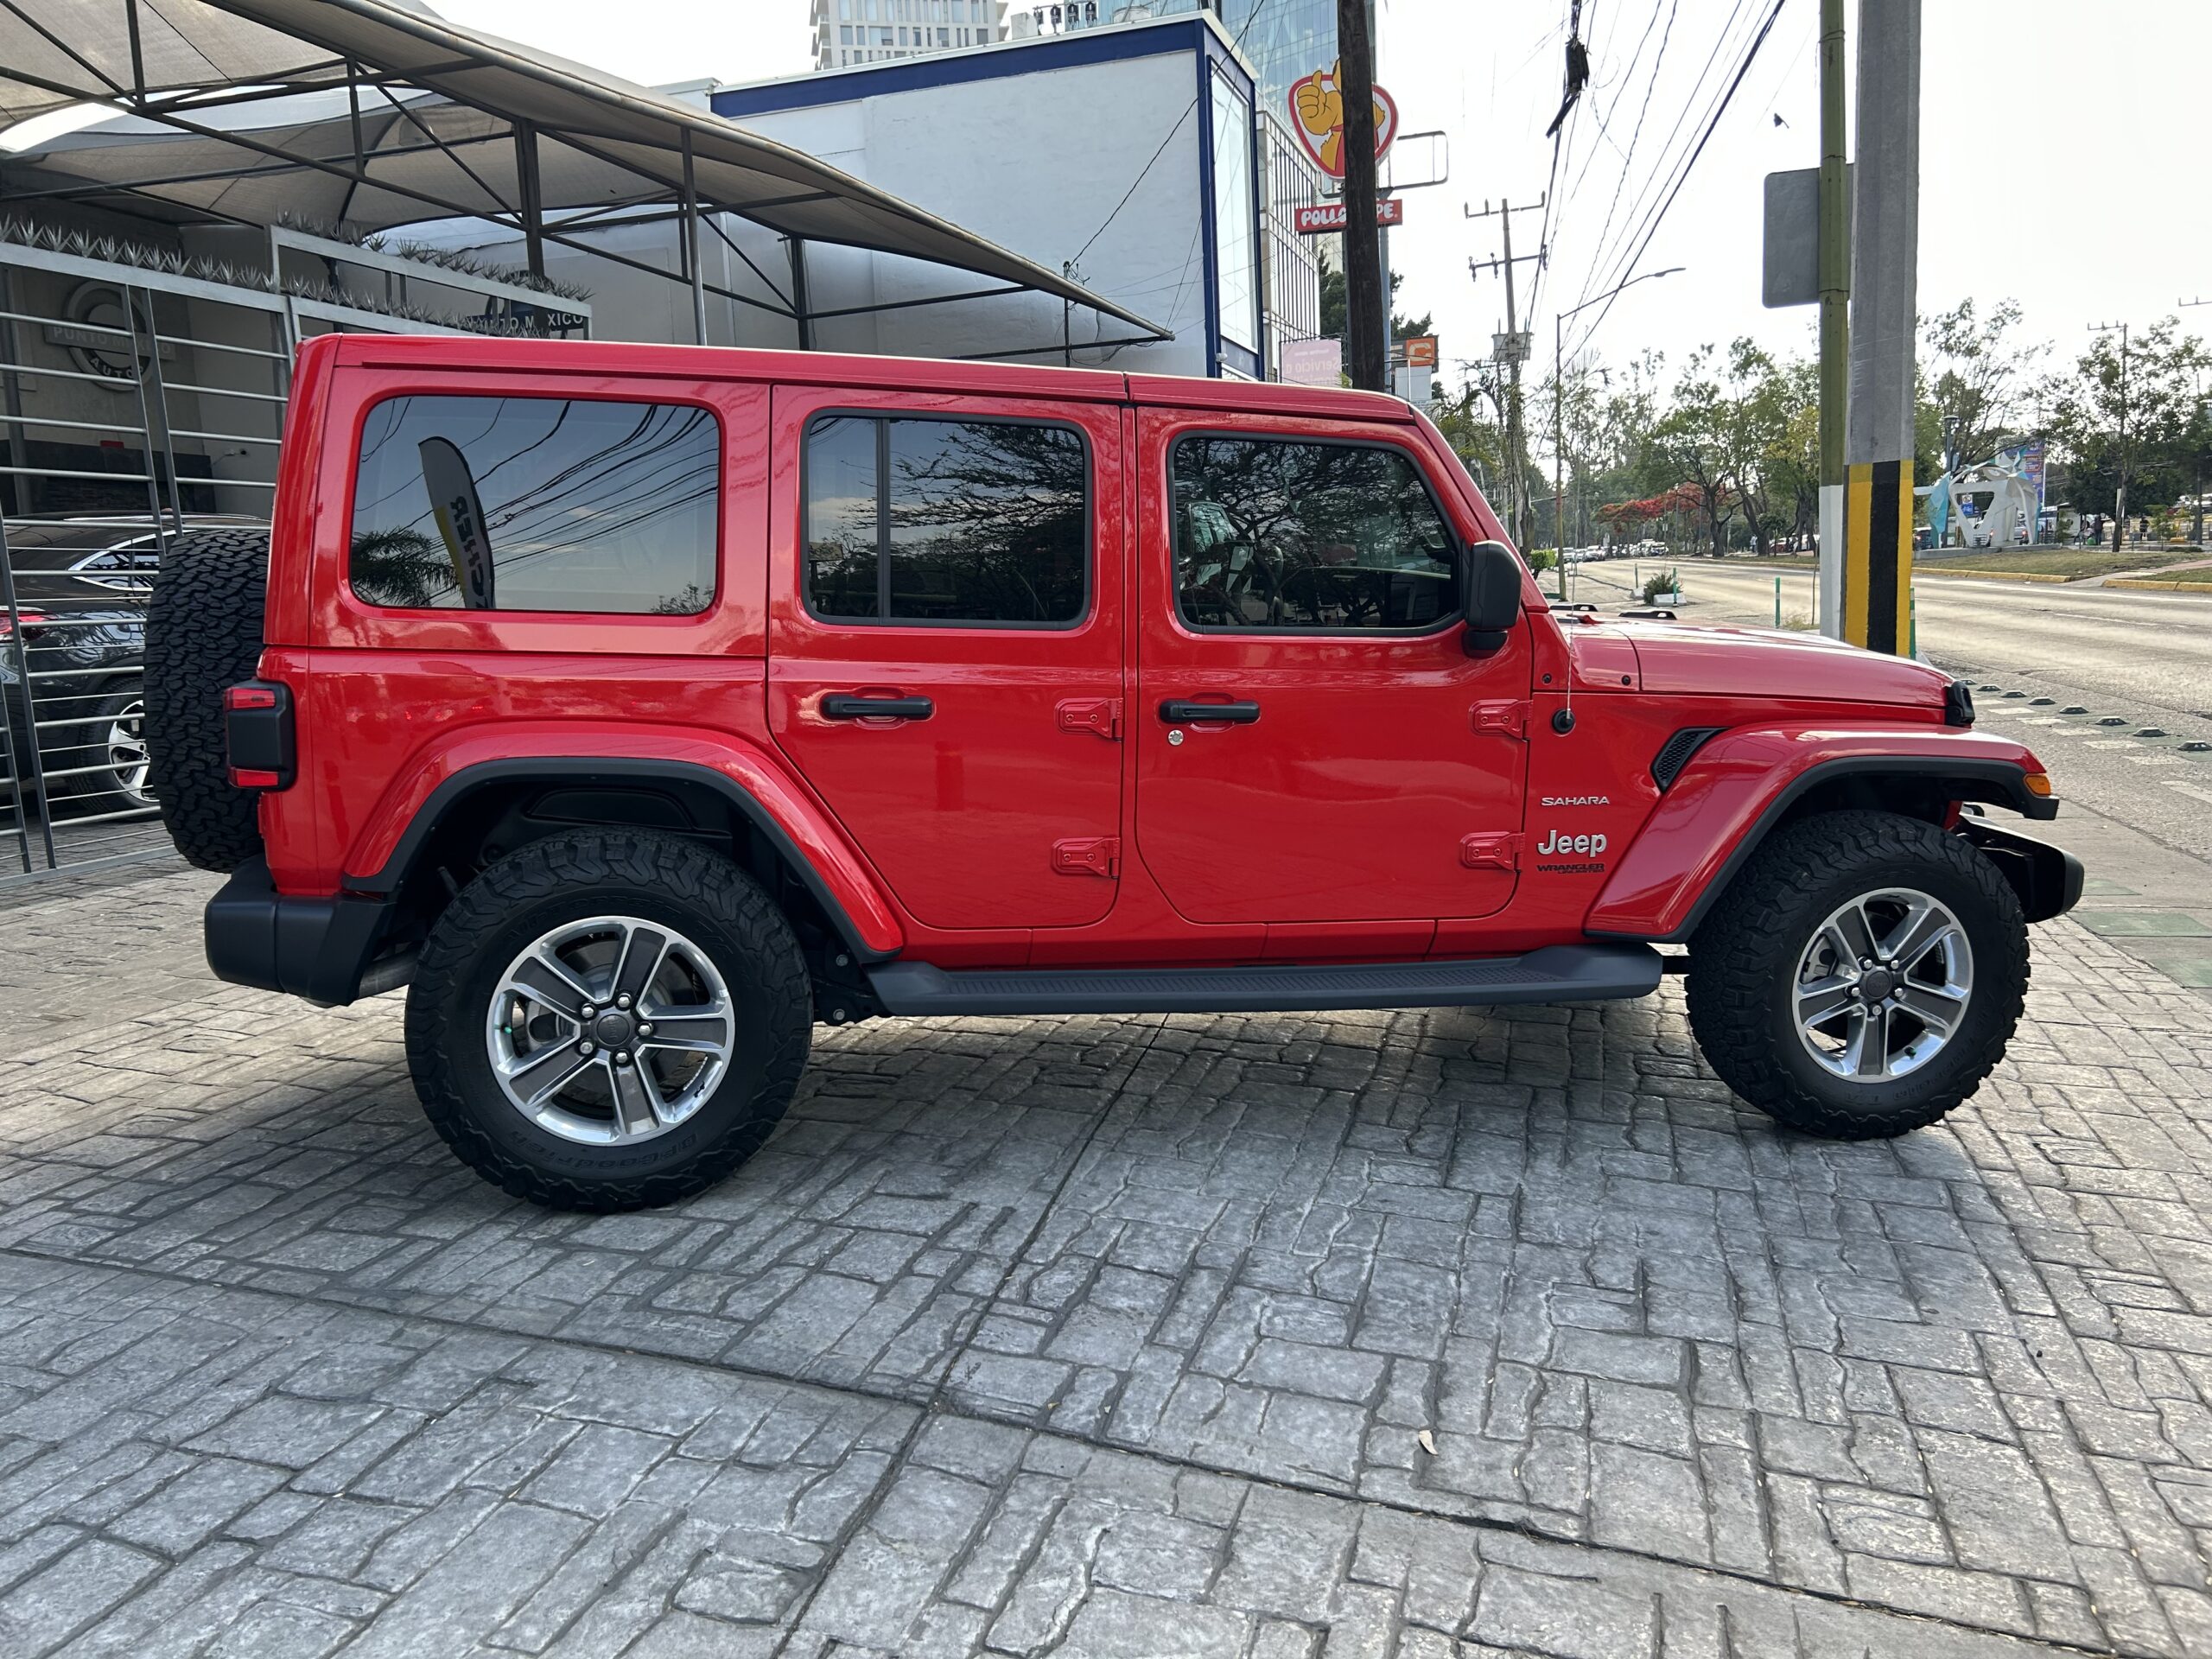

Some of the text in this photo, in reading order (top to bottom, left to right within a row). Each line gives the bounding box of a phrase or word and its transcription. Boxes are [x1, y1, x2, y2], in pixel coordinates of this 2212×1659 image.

[1300, 207, 1346, 226] POLLO
[524, 312, 583, 328] MXICO
[53, 327, 171, 354] PUNTO MXIO
[1541, 796, 1610, 806] SAHARA
[1537, 830, 1607, 858] Jeep
[1537, 863, 1605, 872] WRANGLER
[509, 1130, 698, 1168] BFGoodrich
